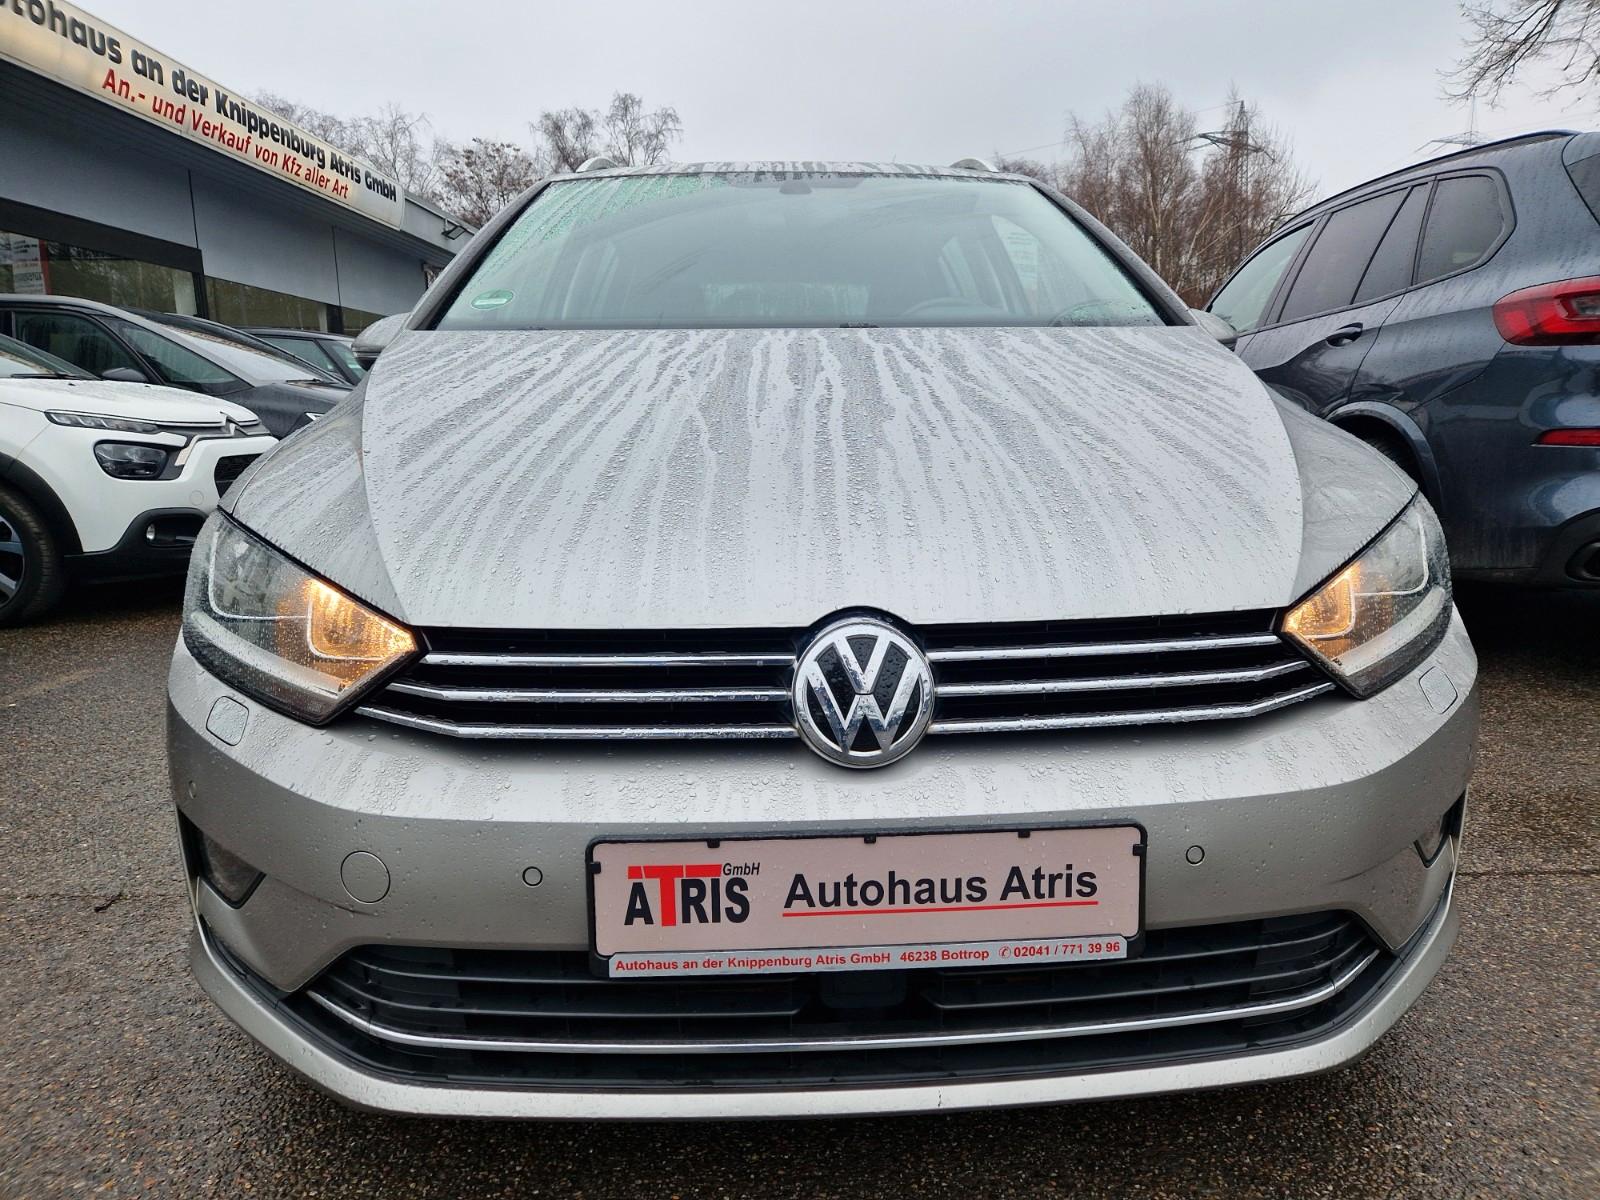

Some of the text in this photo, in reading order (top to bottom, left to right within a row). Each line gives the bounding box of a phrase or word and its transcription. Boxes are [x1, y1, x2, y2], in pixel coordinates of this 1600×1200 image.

[0, 0, 397, 202] tohaus an der Knippenburg Atris GmbH
[152, 96, 187, 125] und
[191, 109, 252, 154] Verkauf
[255, 144, 278, 167] von
[281, 153, 302, 177] Kfz
[305, 166, 331, 190] aller
[332, 178, 349, 200] Art
[624, 862, 761, 927] ATRIS GmbH
[783, 863, 1098, 909] Autohaus Atris
[615, 941, 1121, 971] Autohaus an der Knippenburg Atris GmbH 46238 Bottrop 02041 / 771 39 96
